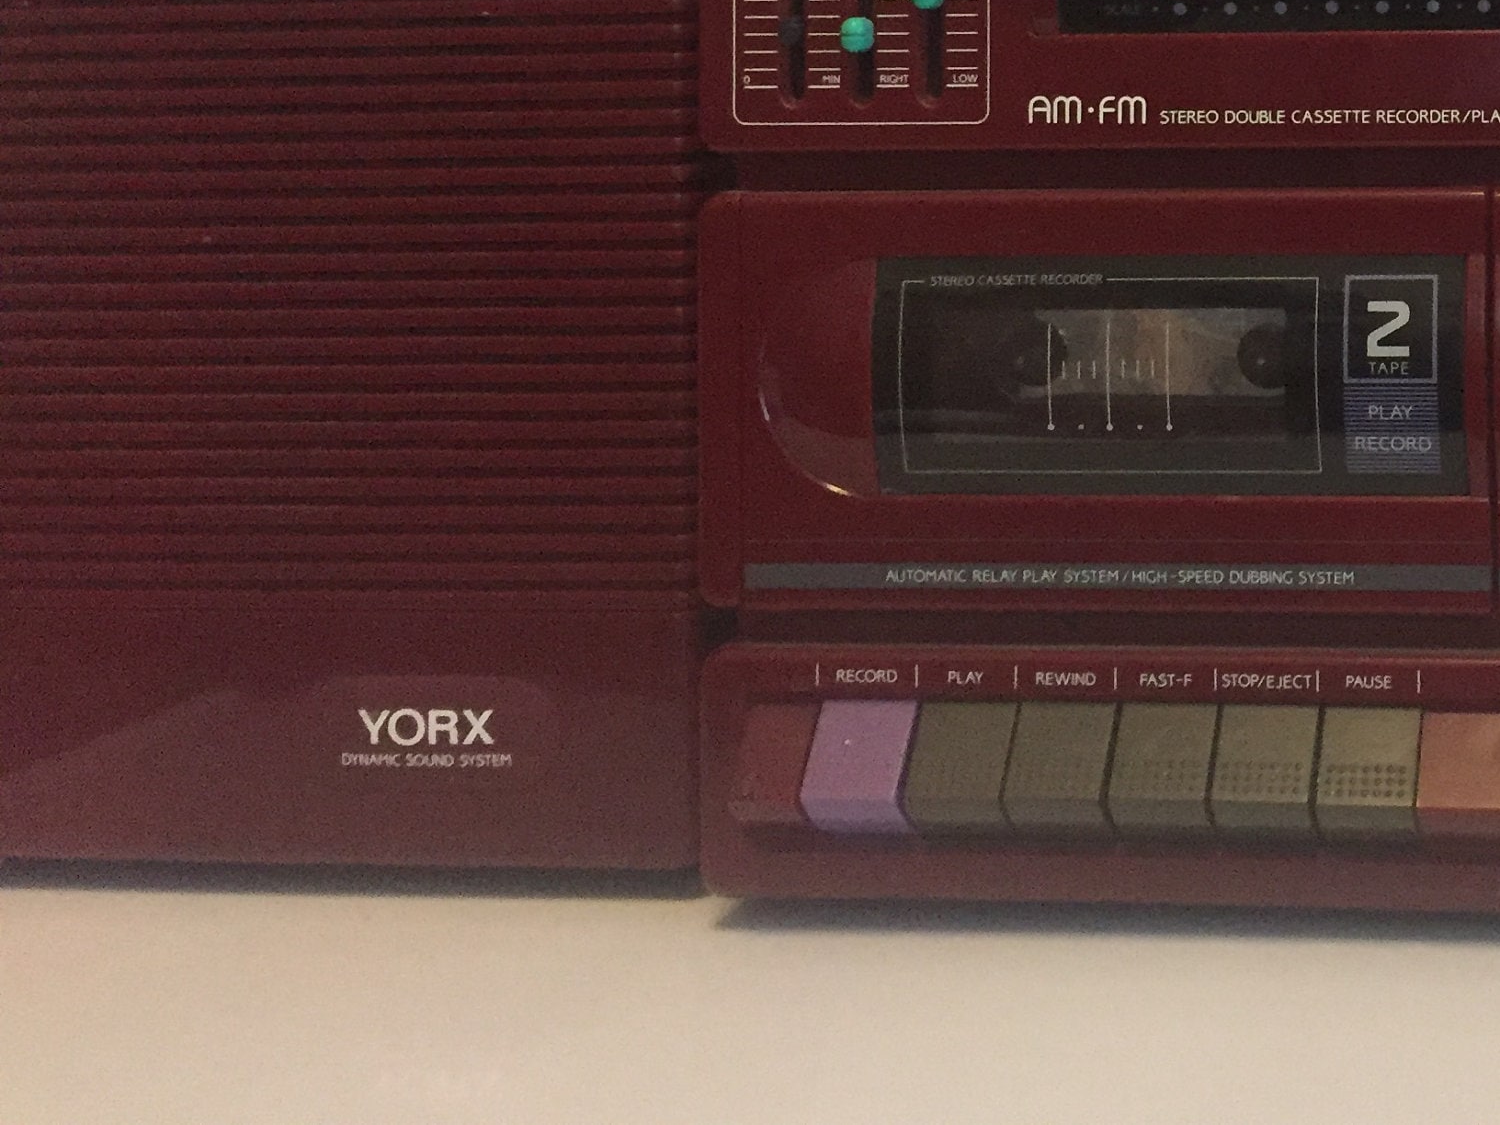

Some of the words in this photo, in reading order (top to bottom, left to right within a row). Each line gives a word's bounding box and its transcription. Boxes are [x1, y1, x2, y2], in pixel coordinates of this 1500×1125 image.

[743, 75, 750, 85] 0
[822, 75, 841, 84] MIN
[879, 74, 909, 84] RIGHT
[953, 74, 978, 83] LOW
[1159, 109, 1219, 125] STEREO
[1225, 109, 1285, 125] DOUBLE
[1291, 109, 1371, 125] CASSETTE
[931, 276, 975, 287] STEREO
[976, 275, 1036, 286] CASSETTE
[1040, 274, 1103, 285] RECORDER
[1367, 300, 1410, 357] 2
[1368, 361, 1409, 375] TAPE
[1368, 405, 1413, 420] PLAY
[1355, 436, 1432, 452] RECORD
[886, 569, 967, 583] AUTOMATIC
[972, 569, 1018, 583] RELAY
[1023, 569, 1057, 583] PLAY
[1229, 570, 1293, 585] DUBBING
[1298, 570, 1354, 585] SYSTEM
[836, 668, 898, 684] RECORD
[948, 670, 984, 685] PLAY
[1035, 671, 1096, 686] REWIND
[1139, 672, 1192, 687] FAST-F
[1221, 673, 1313, 689] STOP/EJECT
[1345, 674, 1392, 690] PAUSE
[358, 708, 495, 746] YORX
[341, 752, 401, 767] DYNAMIC
[406, 753, 455, 768] SOUND
[460, 753, 513, 768] SYSTEM
